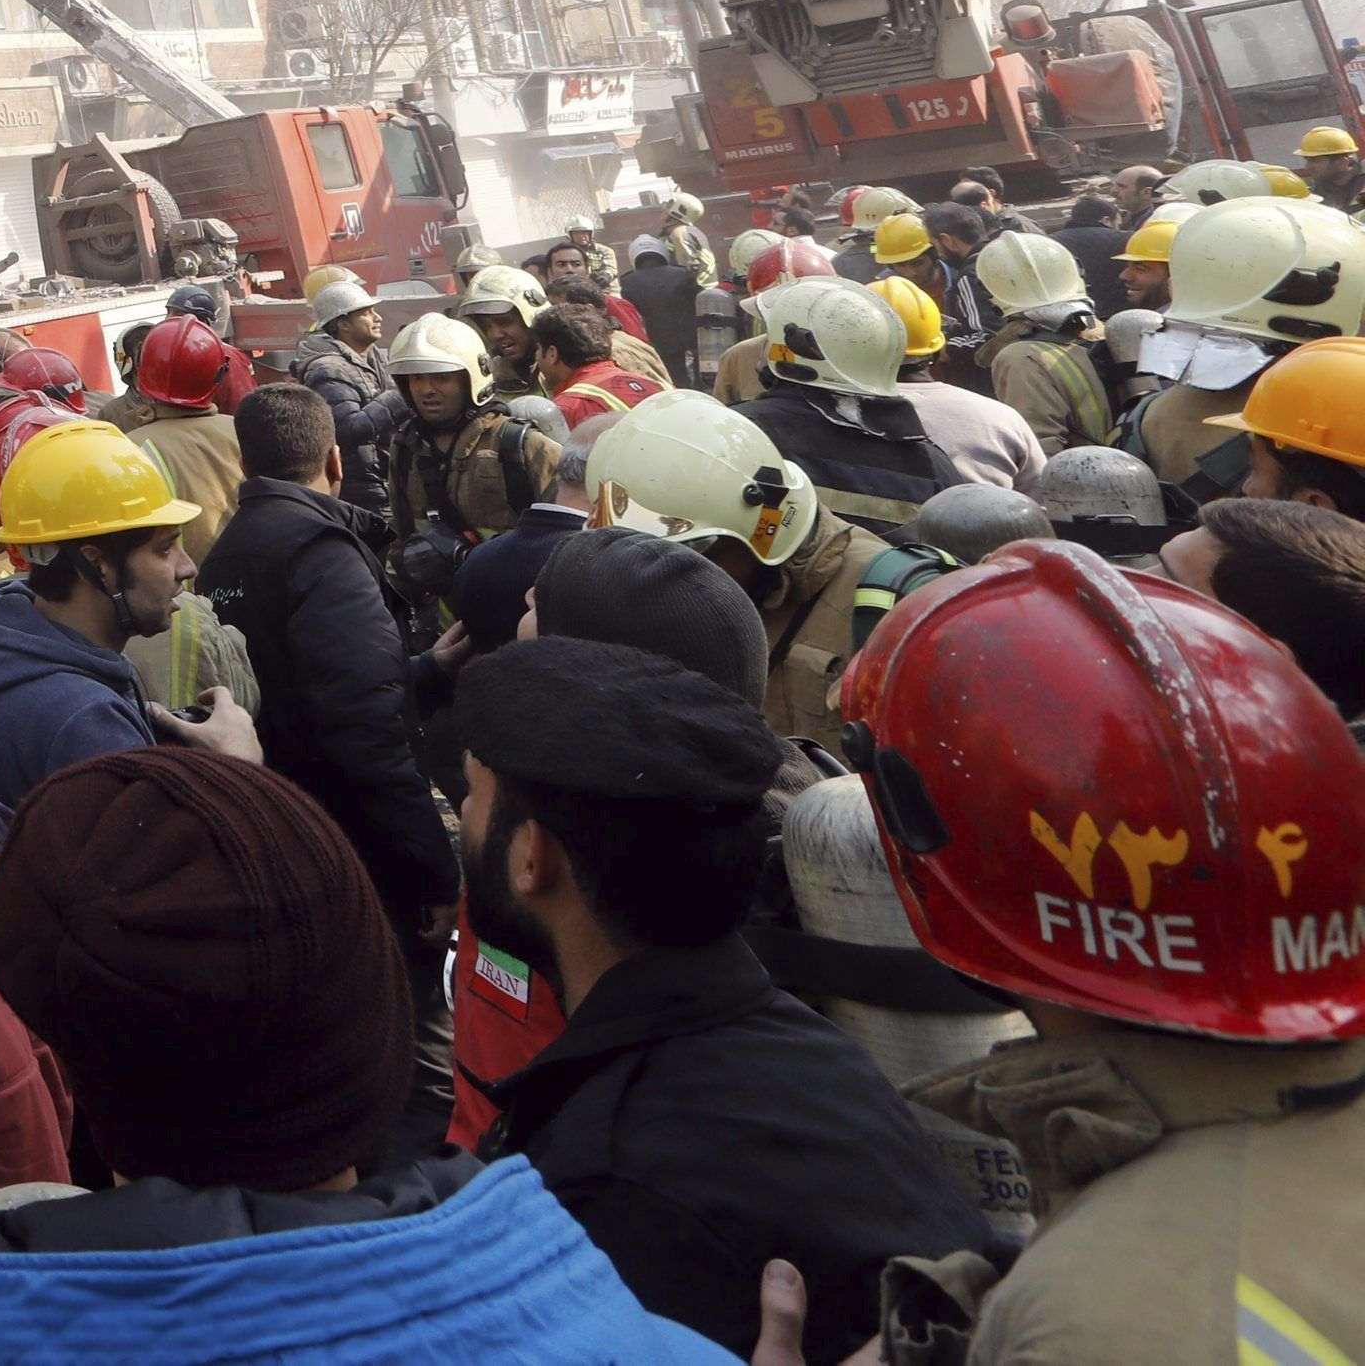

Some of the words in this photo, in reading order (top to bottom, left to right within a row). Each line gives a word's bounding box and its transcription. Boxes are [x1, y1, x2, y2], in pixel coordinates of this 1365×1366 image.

[754, 106, 786, 138] 5
[906, 97, 951, 122] 125
[724, 141, 795, 160] MAGIRUS
[1033, 891, 1205, 974] FIRE
[477, 956, 520, 996] IRAN
